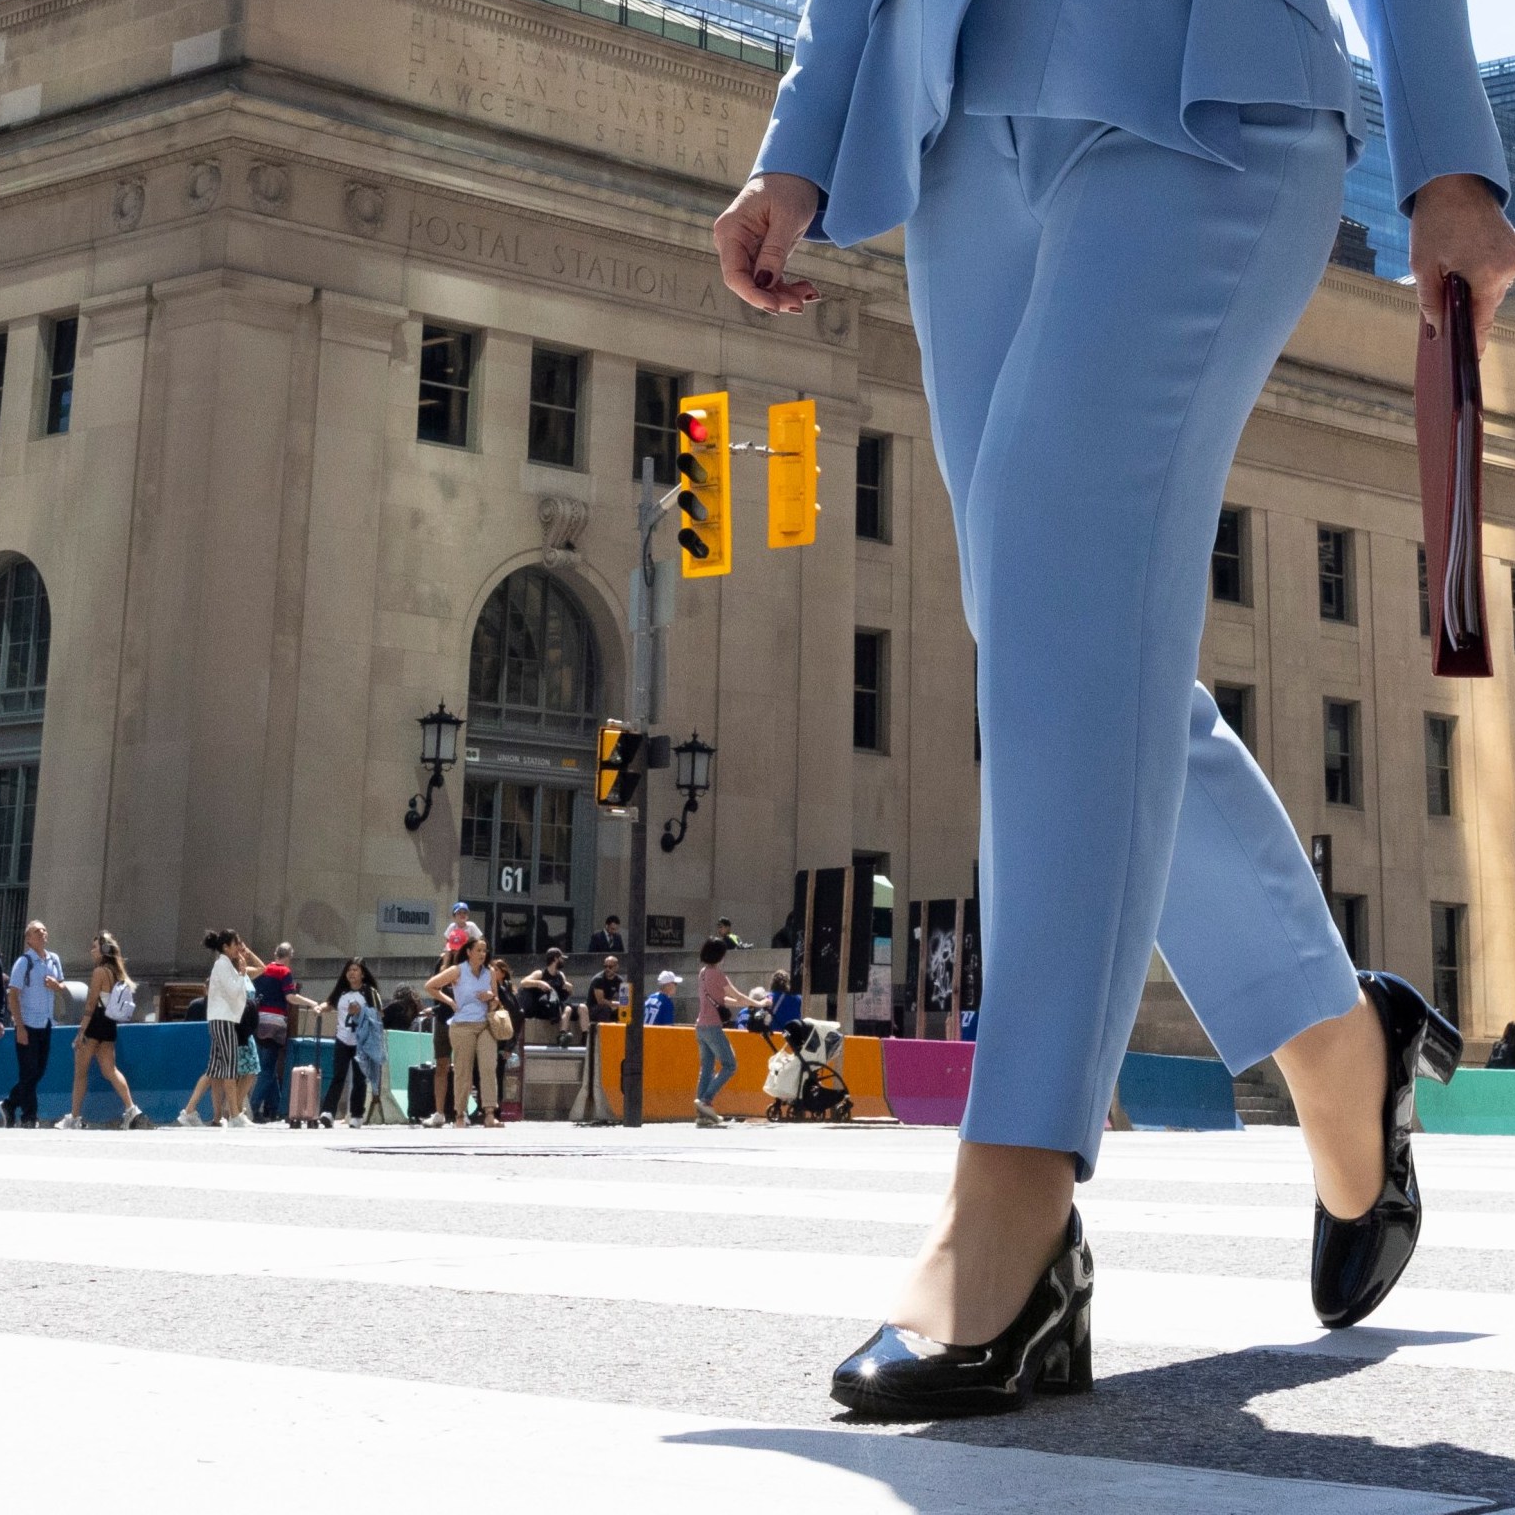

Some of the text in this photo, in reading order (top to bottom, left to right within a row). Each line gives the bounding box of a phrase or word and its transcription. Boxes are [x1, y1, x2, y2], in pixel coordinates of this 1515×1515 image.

[411, 12, 729, 120] HILL FRANKLIN SIKES
[456, 57, 686, 135] ALLAN CUNARD
[407, 72, 729, 174] FAWCETT STEPHAN
[408, 209, 718, 311] POSTAL STATION A
[523, 756, 551, 767] STATION
[501, 866, 523, 893] 61
